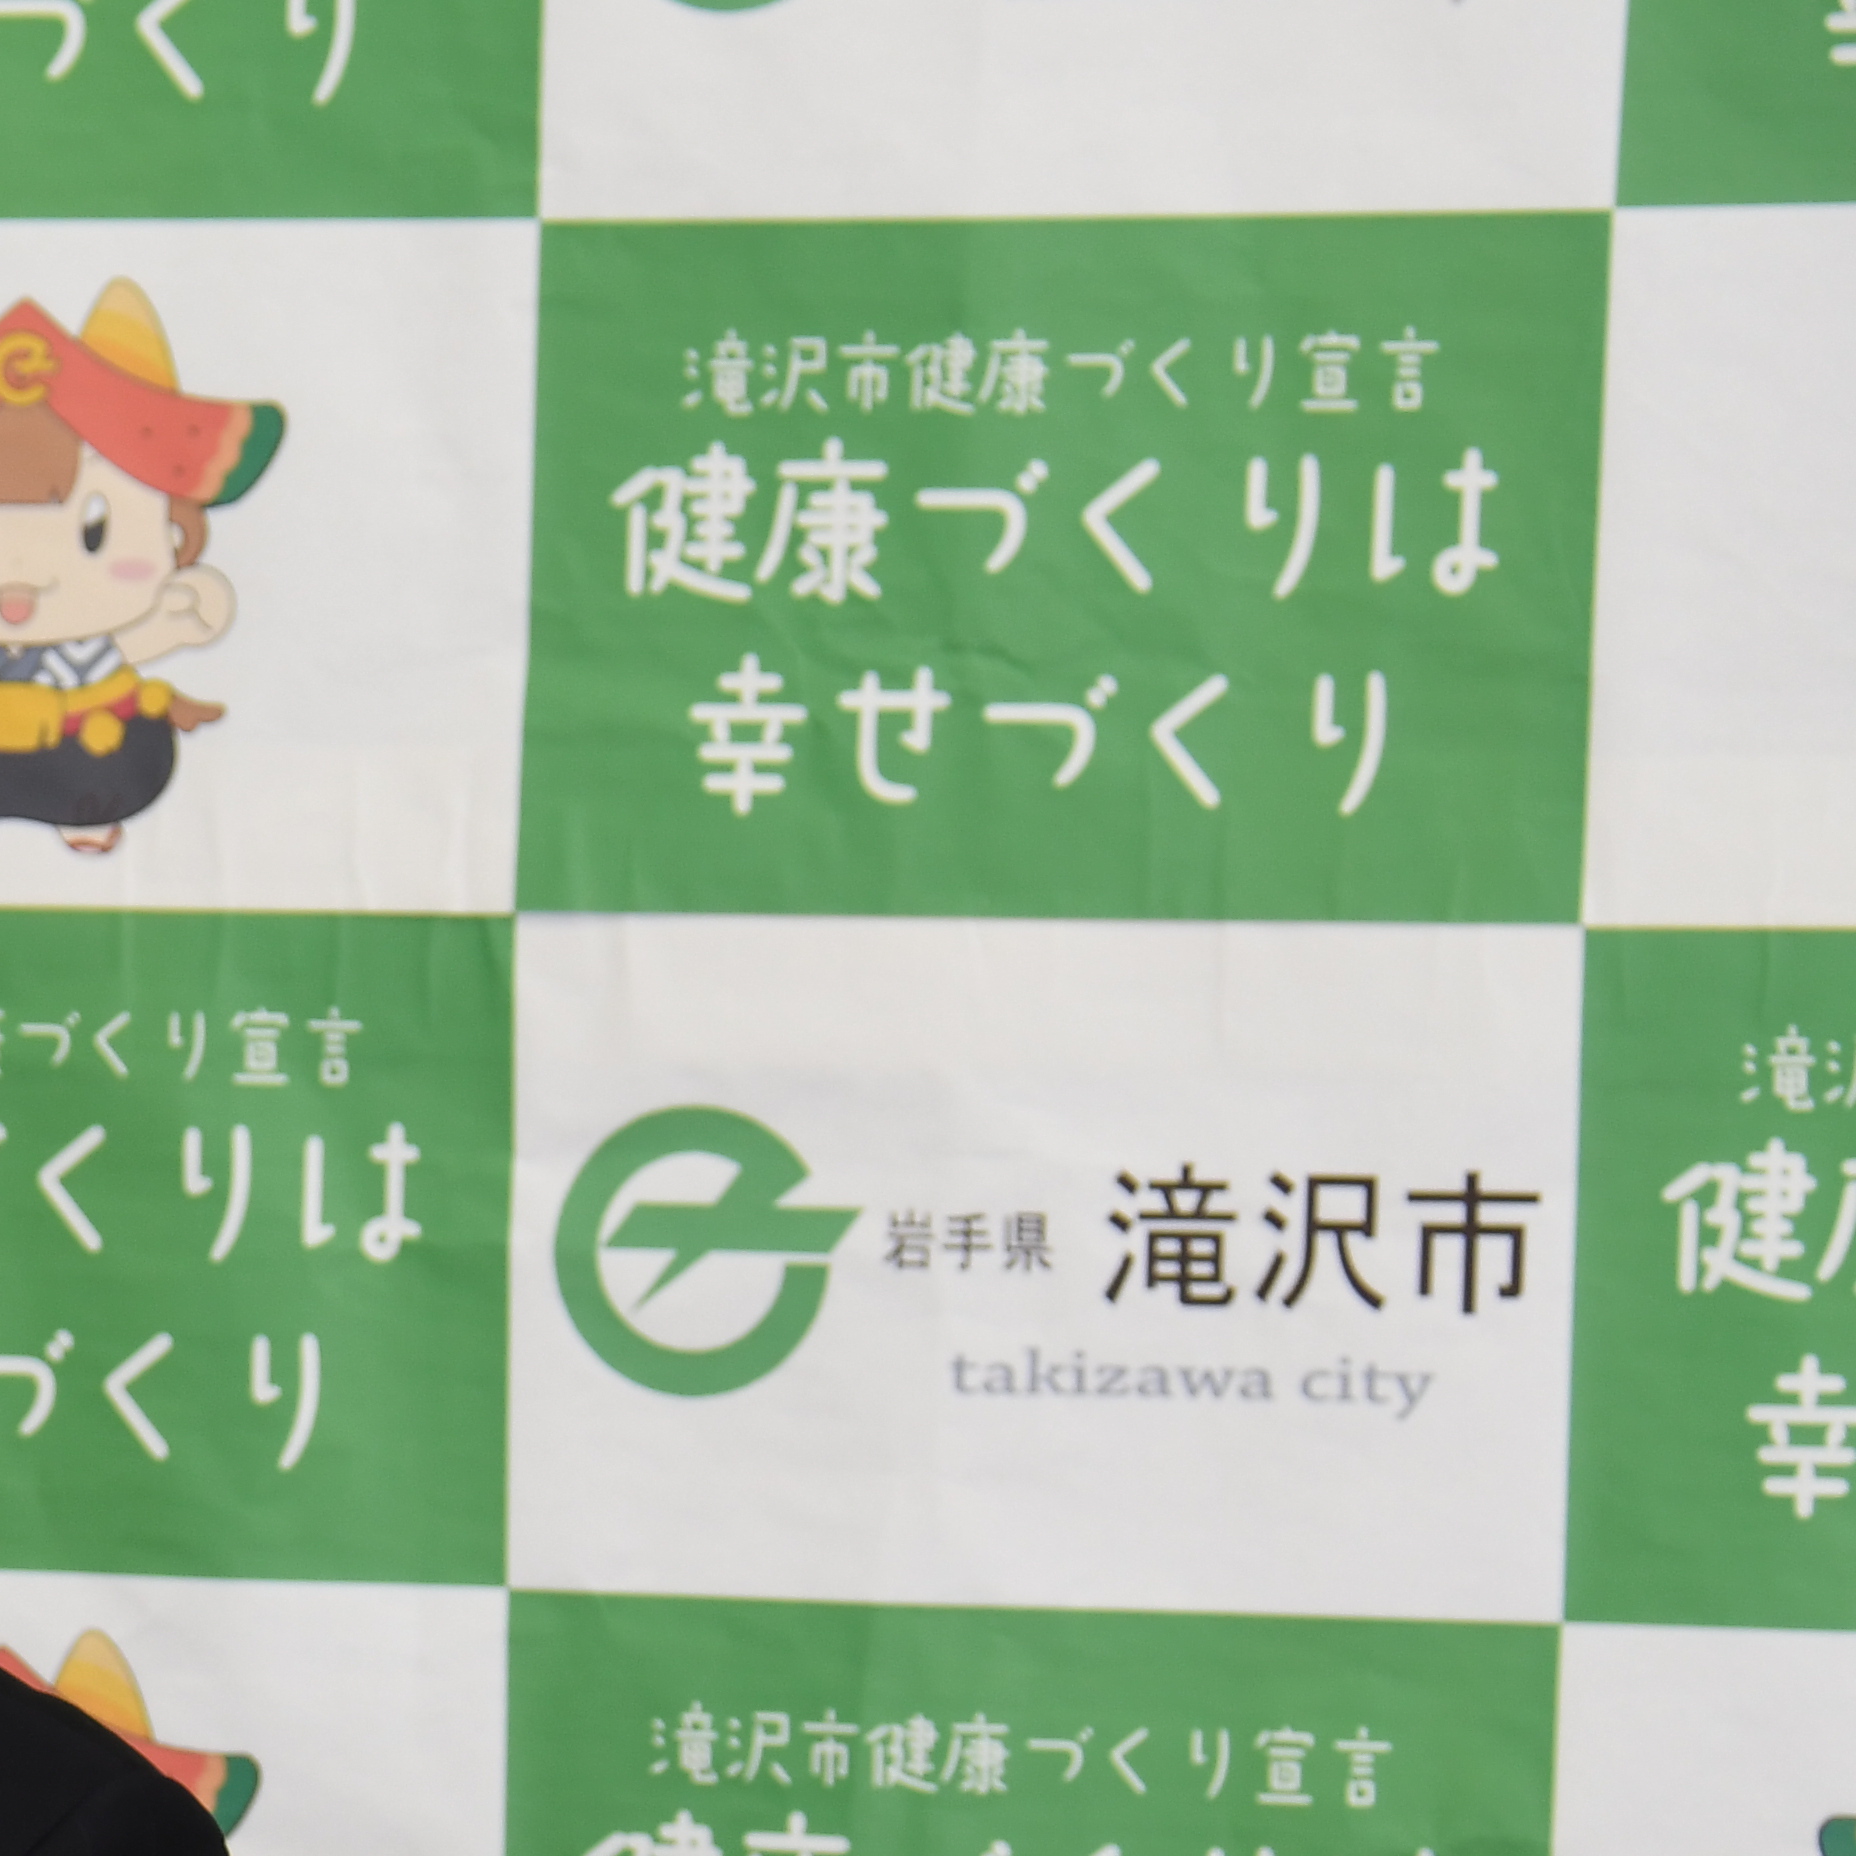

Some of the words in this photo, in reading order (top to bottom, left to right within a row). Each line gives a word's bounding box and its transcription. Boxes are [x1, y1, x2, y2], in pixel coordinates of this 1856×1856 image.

[682, 326, 1439, 414] 滝沢市健康づくり宣言
[609, 436, 1500, 607] 健康づくりは
[687, 652, 1389, 818] 幸せづくり
[884, 1210, 1053, 1272] 岩手県
[1102, 1160, 1544, 1318] 滝沢市
[949, 1345, 1276, 1404] takizawa
[1296, 1354, 1436, 1423] city
[650, 1700, 1393, 1808] 滝沢市健康づくり宣言
